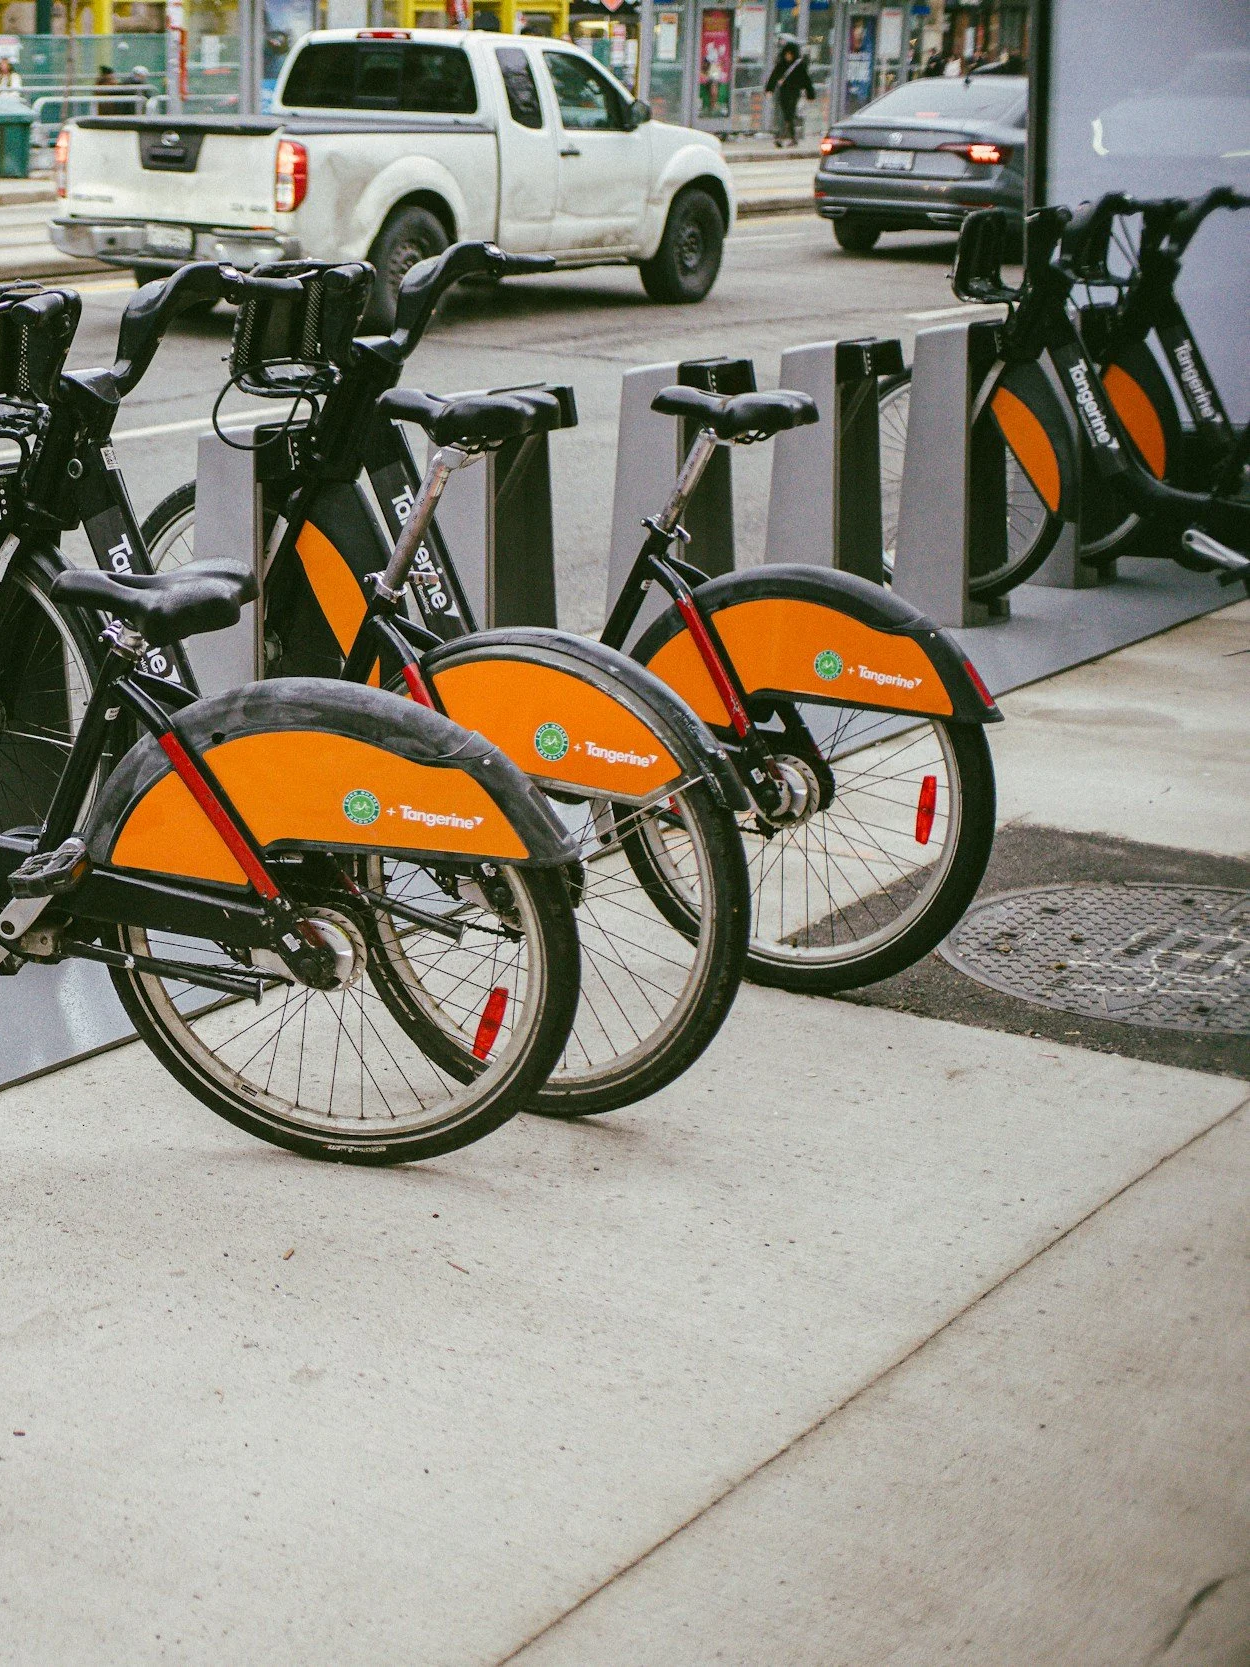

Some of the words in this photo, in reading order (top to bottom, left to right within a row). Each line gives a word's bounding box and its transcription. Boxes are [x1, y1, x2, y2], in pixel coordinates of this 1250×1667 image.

[1174, 338, 1215, 419] Tangerine
[1069, 358, 1111, 443] Tangerine
[858, 664, 915, 689] Tangerine
[585, 741, 650, 768] Tangerine
[399, 804, 475, 830] Tangerine
